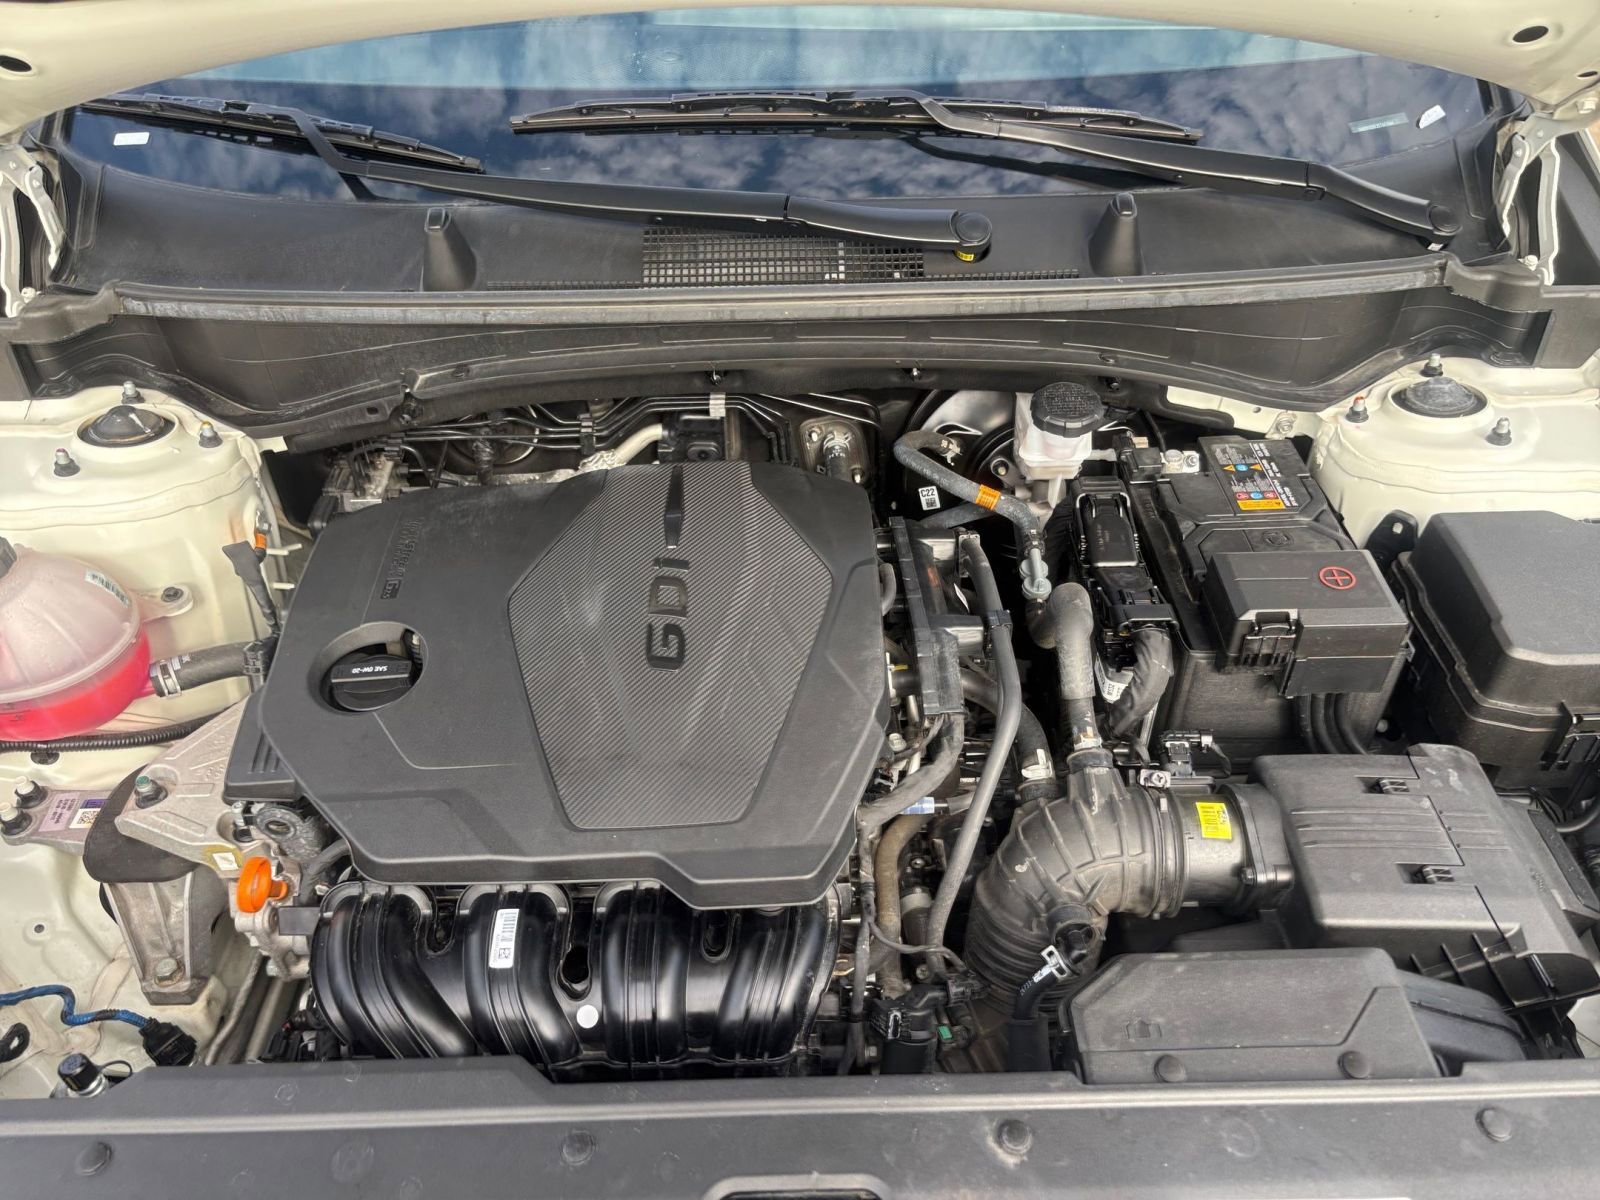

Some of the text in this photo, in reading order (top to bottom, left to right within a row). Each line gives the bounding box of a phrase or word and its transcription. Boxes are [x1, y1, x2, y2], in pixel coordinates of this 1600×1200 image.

[920, 488, 936, 498] C22
[352, 665, 388, 674] SAE 0W-20
